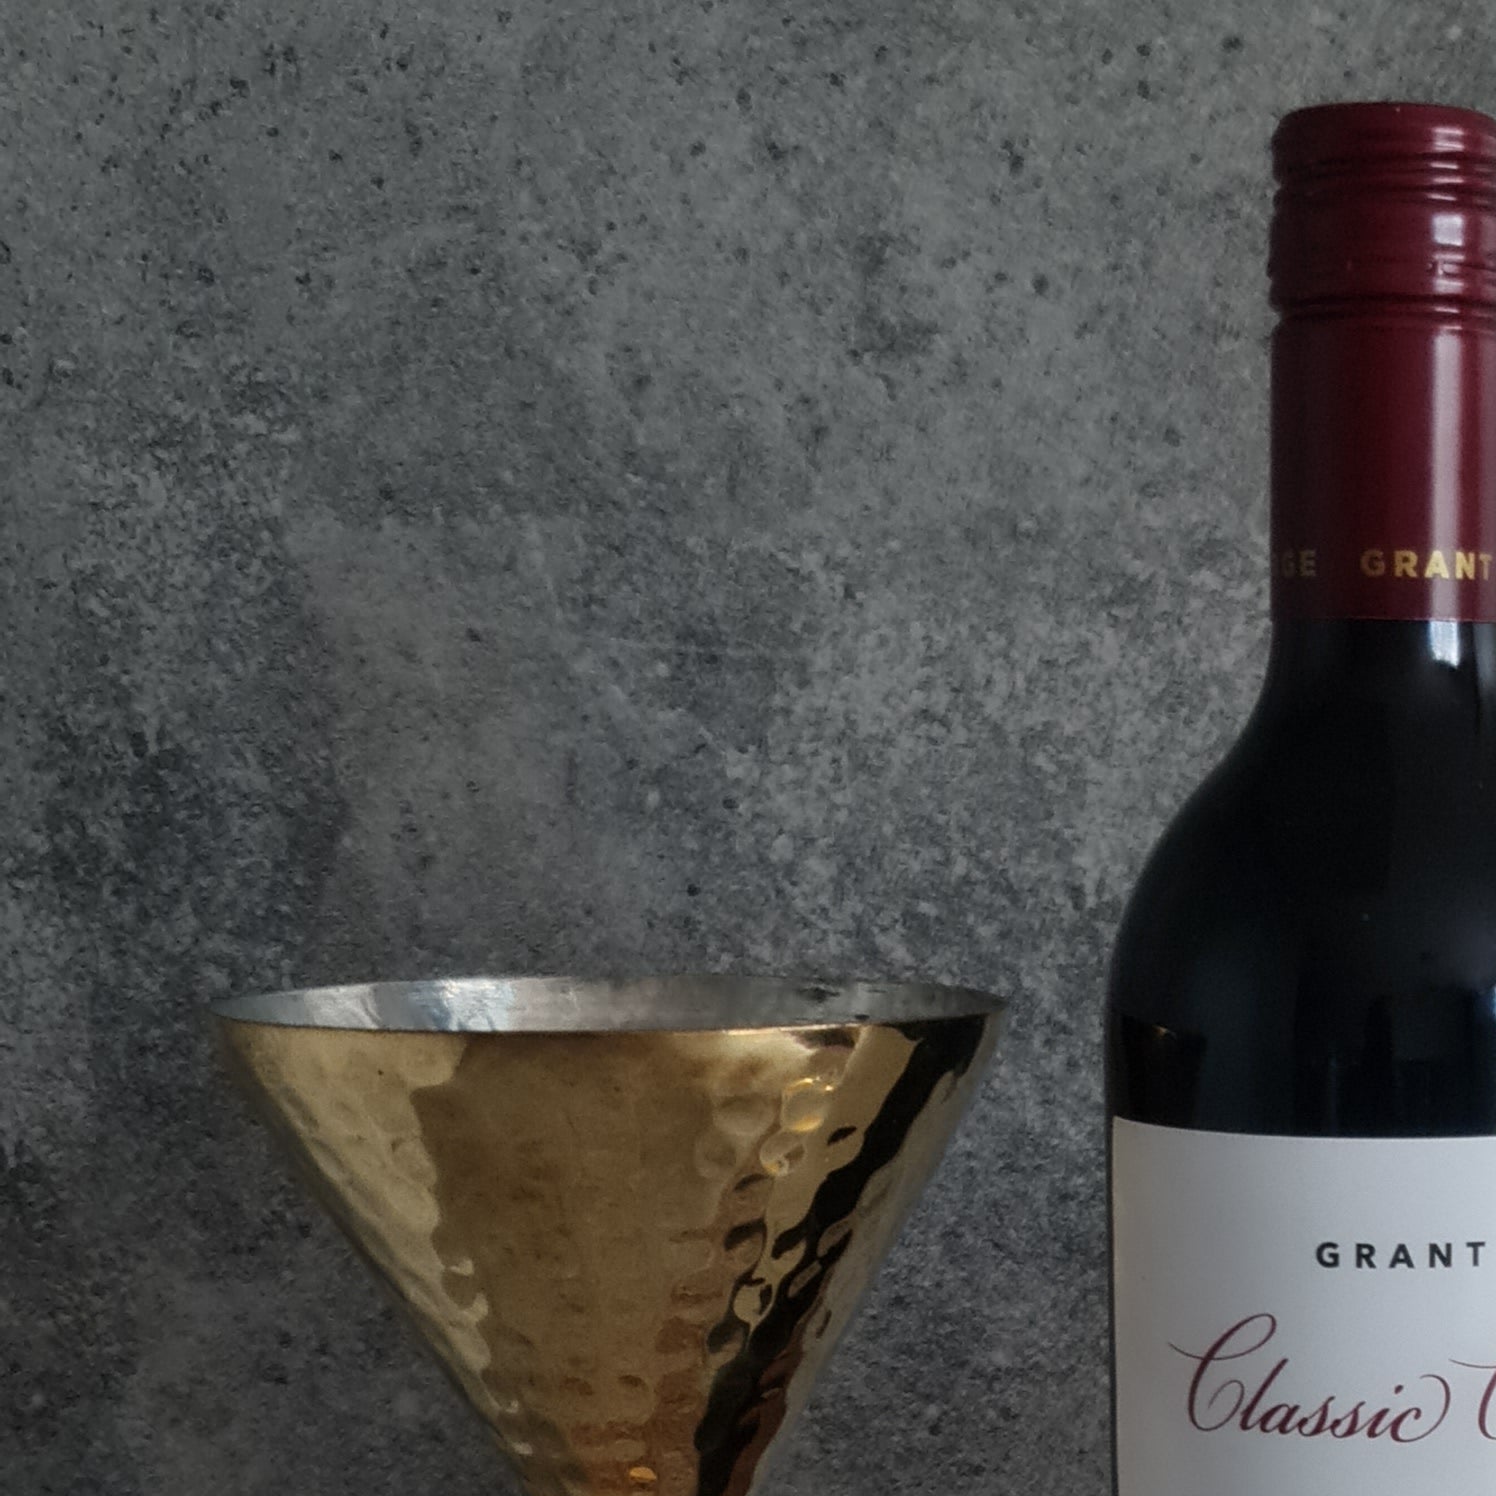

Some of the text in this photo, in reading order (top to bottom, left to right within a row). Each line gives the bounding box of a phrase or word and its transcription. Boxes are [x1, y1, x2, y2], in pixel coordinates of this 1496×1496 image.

[1359, 550, 1493, 580] GRANT
[1315, 1241, 1486, 1269] GRANT
[1168, 1313, 1451, 1443] Classic
